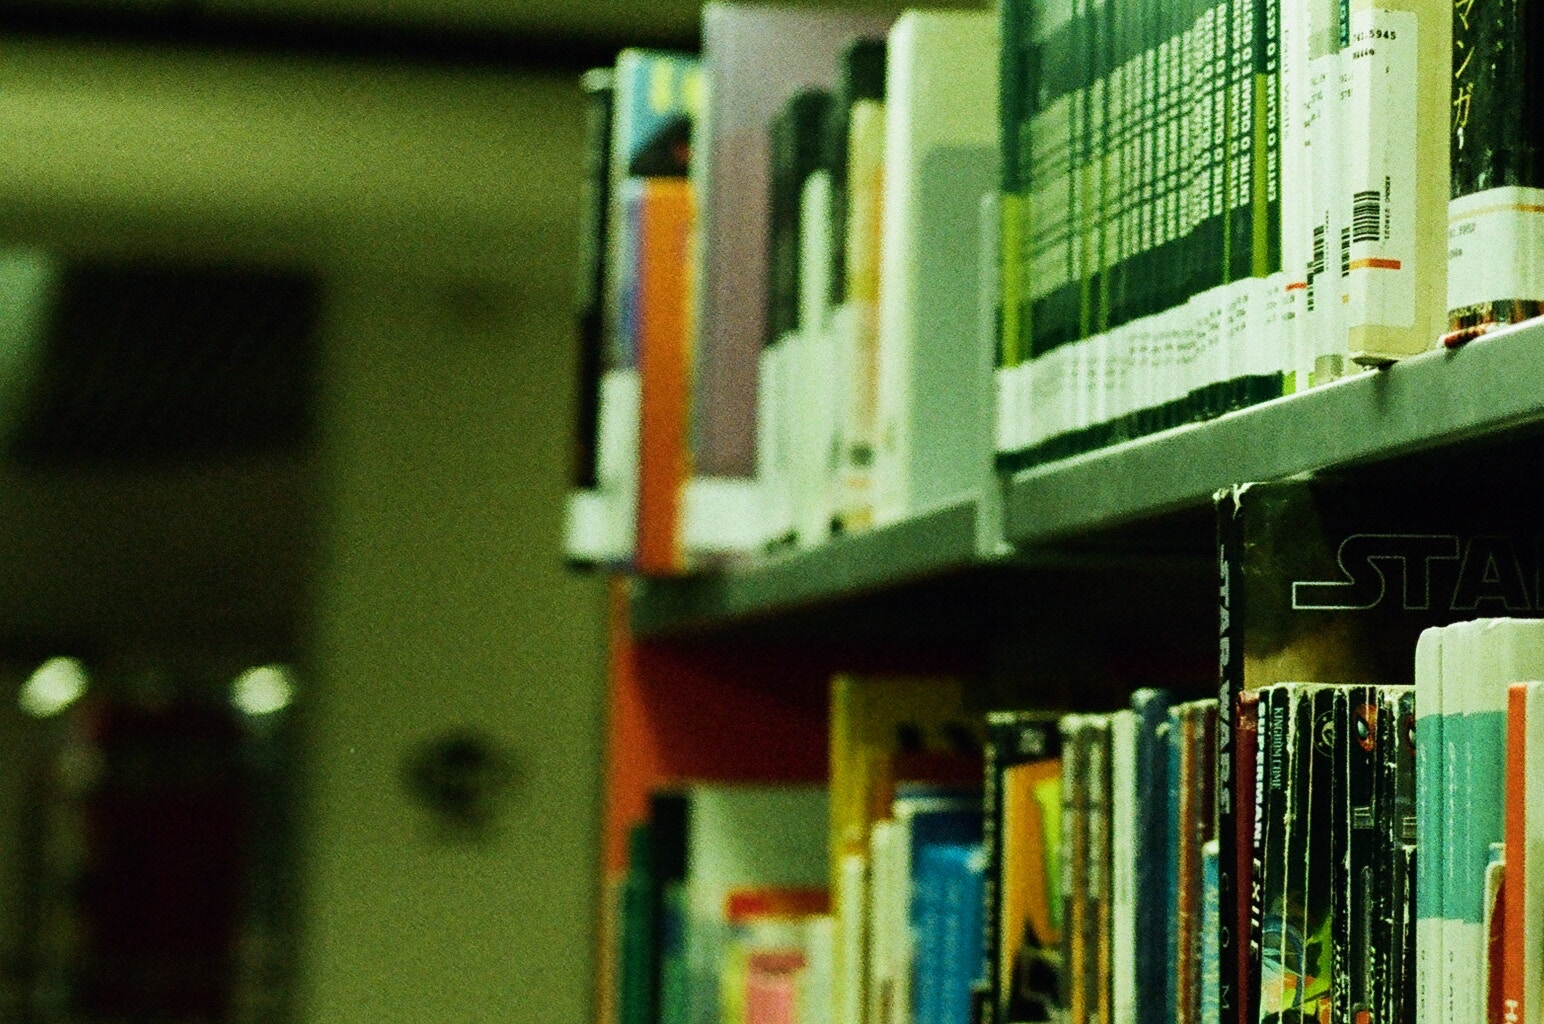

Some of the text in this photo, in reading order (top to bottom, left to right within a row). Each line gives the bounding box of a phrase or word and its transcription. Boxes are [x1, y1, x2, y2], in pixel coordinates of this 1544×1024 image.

[1267, 42, 1276, 56] O
[1267, 59, 1276, 70] E
[1241, 77, 1252, 133] OLHAR
[1267, 73, 1276, 129] OLHAR
[1267, 133, 1276, 146] O
[1240, 152, 1250, 206] ENTRE
[1267, 149, 1276, 202] ENTRE
